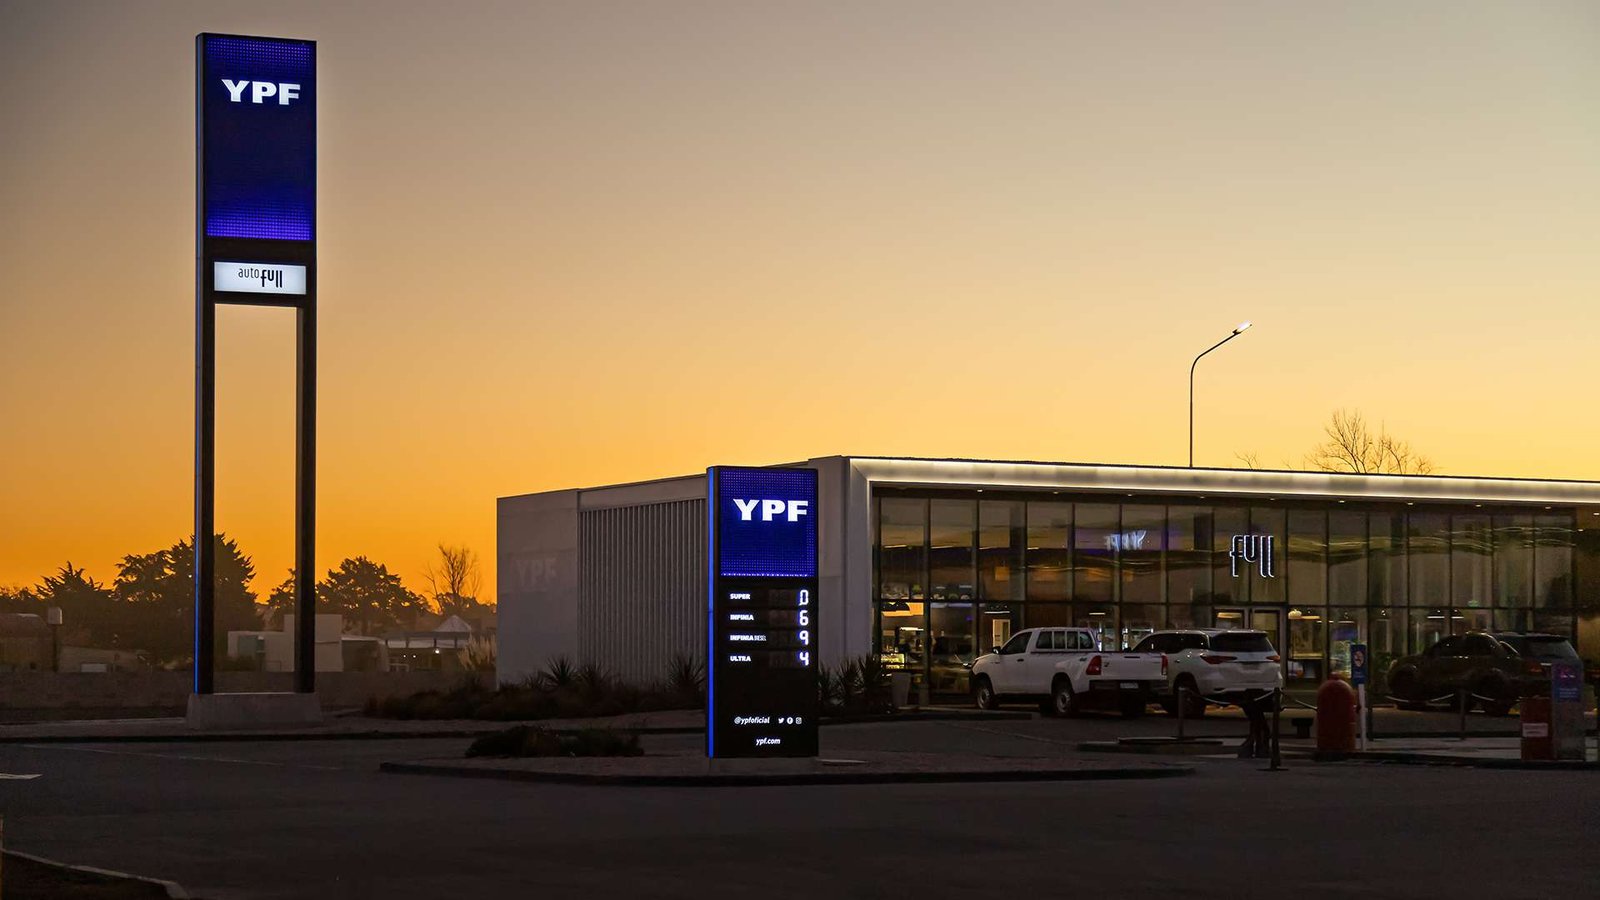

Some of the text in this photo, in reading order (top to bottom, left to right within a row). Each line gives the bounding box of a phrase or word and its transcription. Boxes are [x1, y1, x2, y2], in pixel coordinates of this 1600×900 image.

[221, 79, 301, 105] YPF
[238, 267, 283, 288] auto full
[733, 498, 808, 521] YPF
[1229, 534, 1275, 577] full
[799, 609, 809, 626] 6
[799, 630, 809, 645] 9
[799, 651, 809, 666] 4
[733, 716, 770, 725] @ypfoficial
[755, 737, 781, 746] ypf.com
